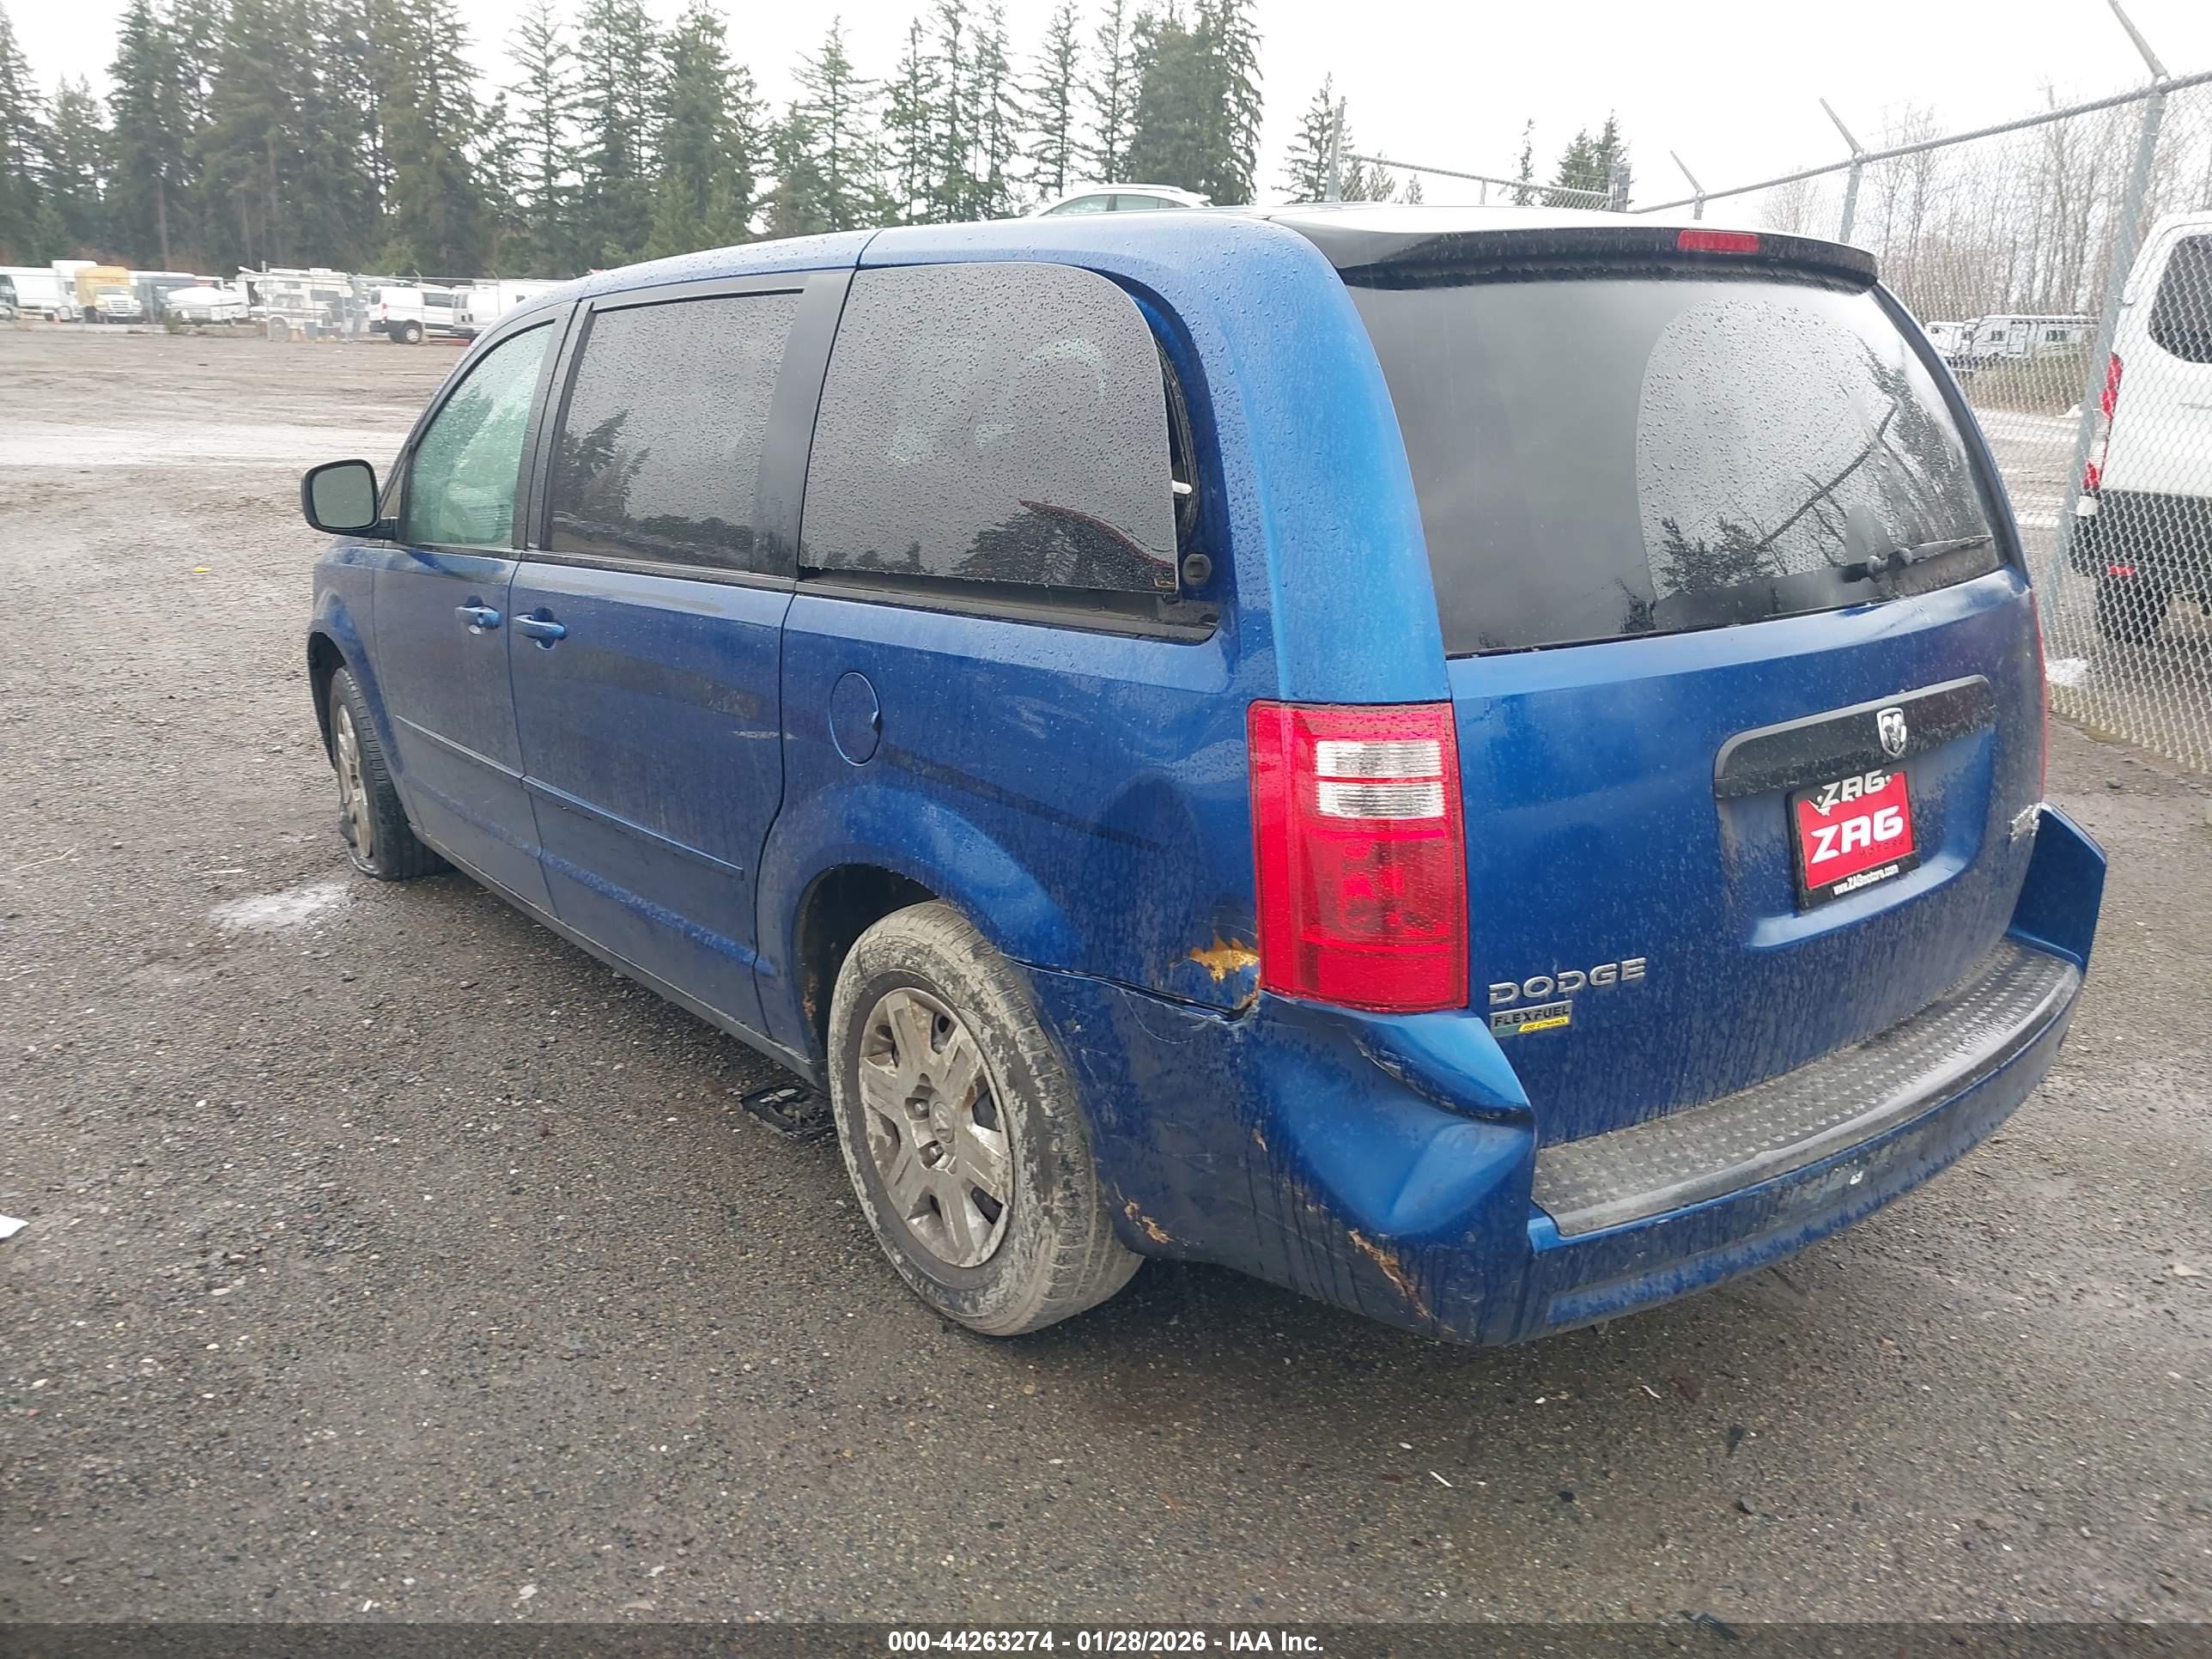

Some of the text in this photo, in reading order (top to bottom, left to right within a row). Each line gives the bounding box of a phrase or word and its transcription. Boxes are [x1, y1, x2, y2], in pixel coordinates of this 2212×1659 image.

[1820, 769, 1885, 807] ZAG
[1810, 805, 1904, 864] ZAG
[1488, 957, 1647, 1005] DODGE
